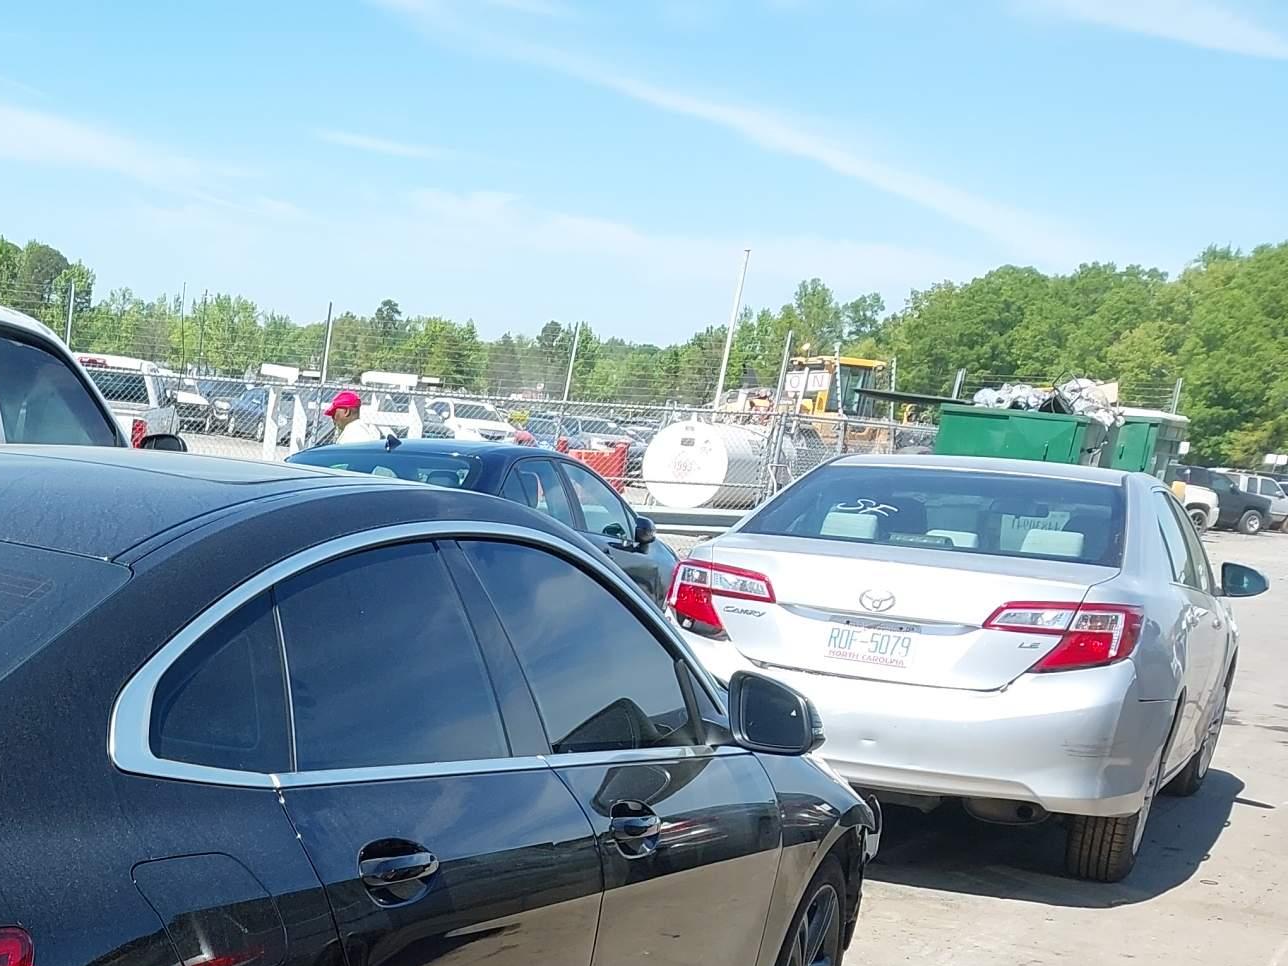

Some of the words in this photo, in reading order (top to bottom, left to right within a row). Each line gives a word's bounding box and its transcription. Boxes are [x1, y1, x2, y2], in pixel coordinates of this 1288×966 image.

[1017, 641, 1041, 649] LE
[828, 649, 859, 660] NORTH
[861, 654, 905, 666] CAROLINA
